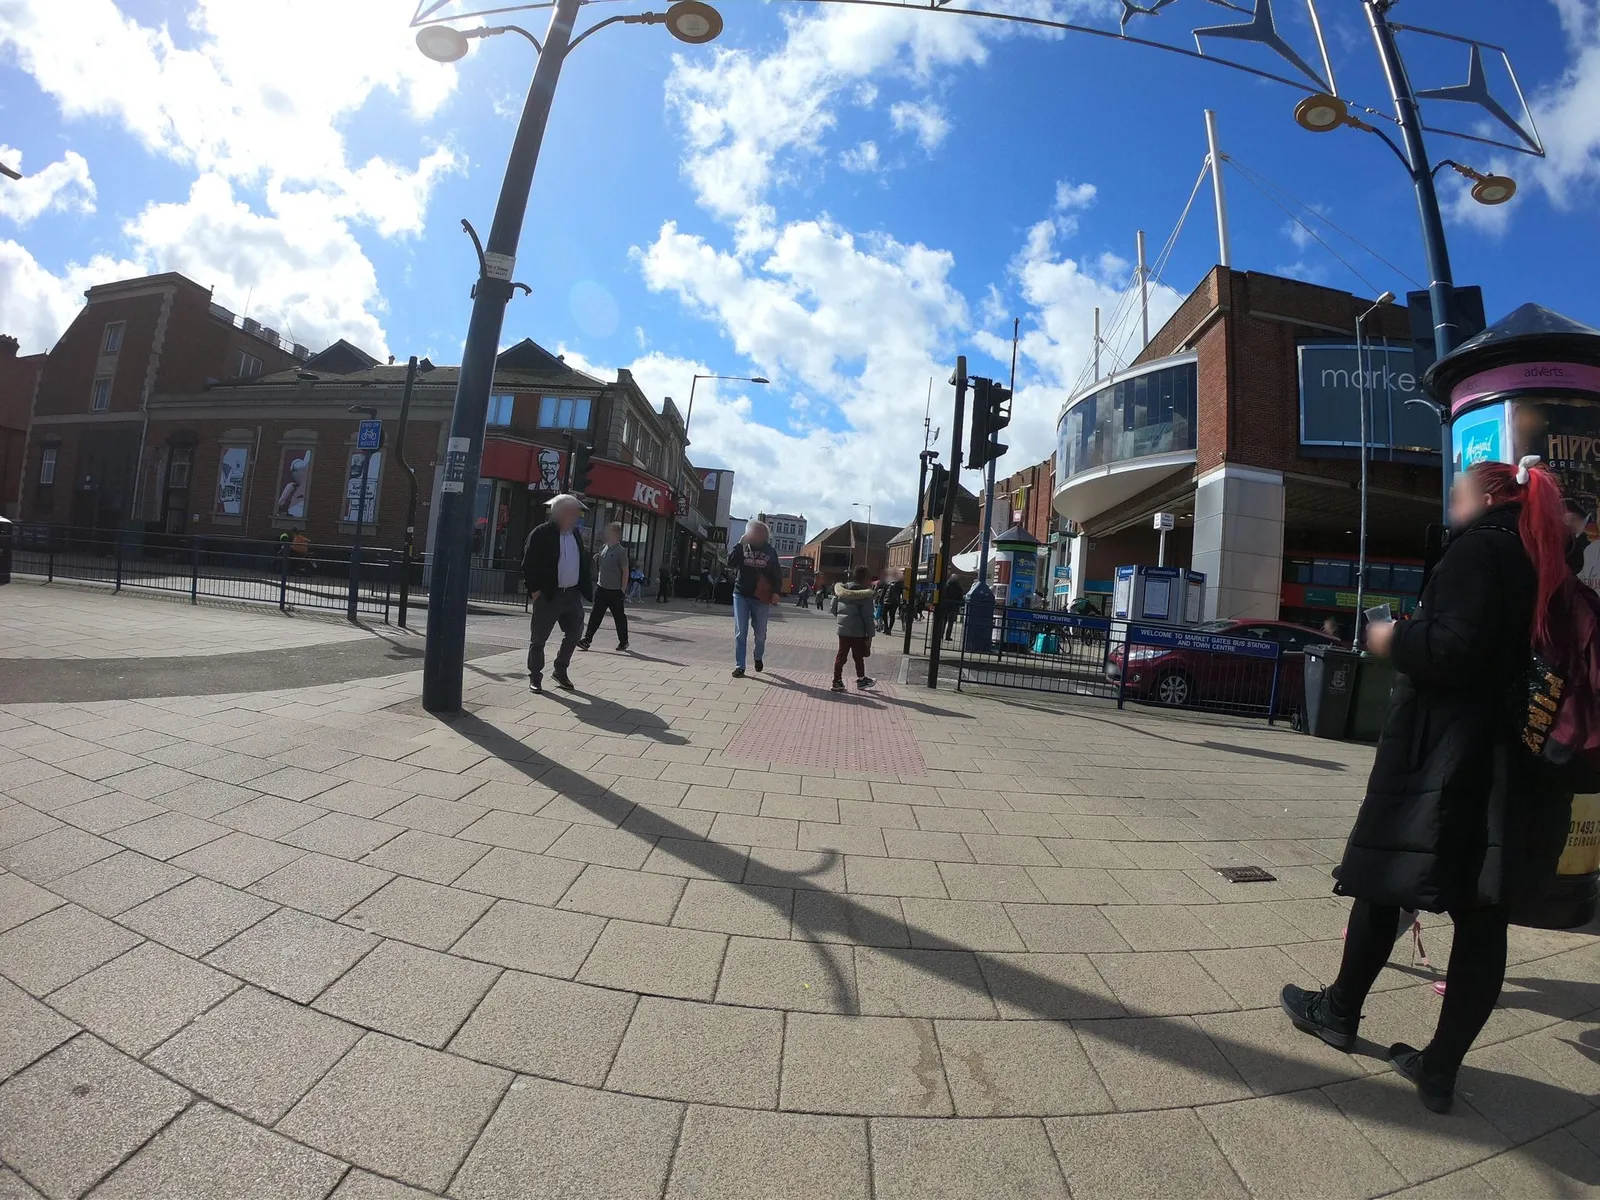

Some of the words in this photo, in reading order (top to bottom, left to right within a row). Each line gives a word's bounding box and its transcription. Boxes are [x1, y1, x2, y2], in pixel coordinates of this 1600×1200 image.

[1524, 366, 1564, 377] adverts
[1321, 365, 1424, 393] marke
[1549, 460, 1592, 471] GREAT
[632, 481, 662, 509] KFC
[1050, 615, 1071, 623] CENTRE
[1140, 629, 1173, 639] WELCOME
[1185, 634, 1209, 643] MARKET
[1211, 637, 1231, 645] GATES
[1232, 639, 1246, 647] BUS
[1247, 641, 1271, 650] STATION
[1212, 643, 1236, 652] CENTRE
